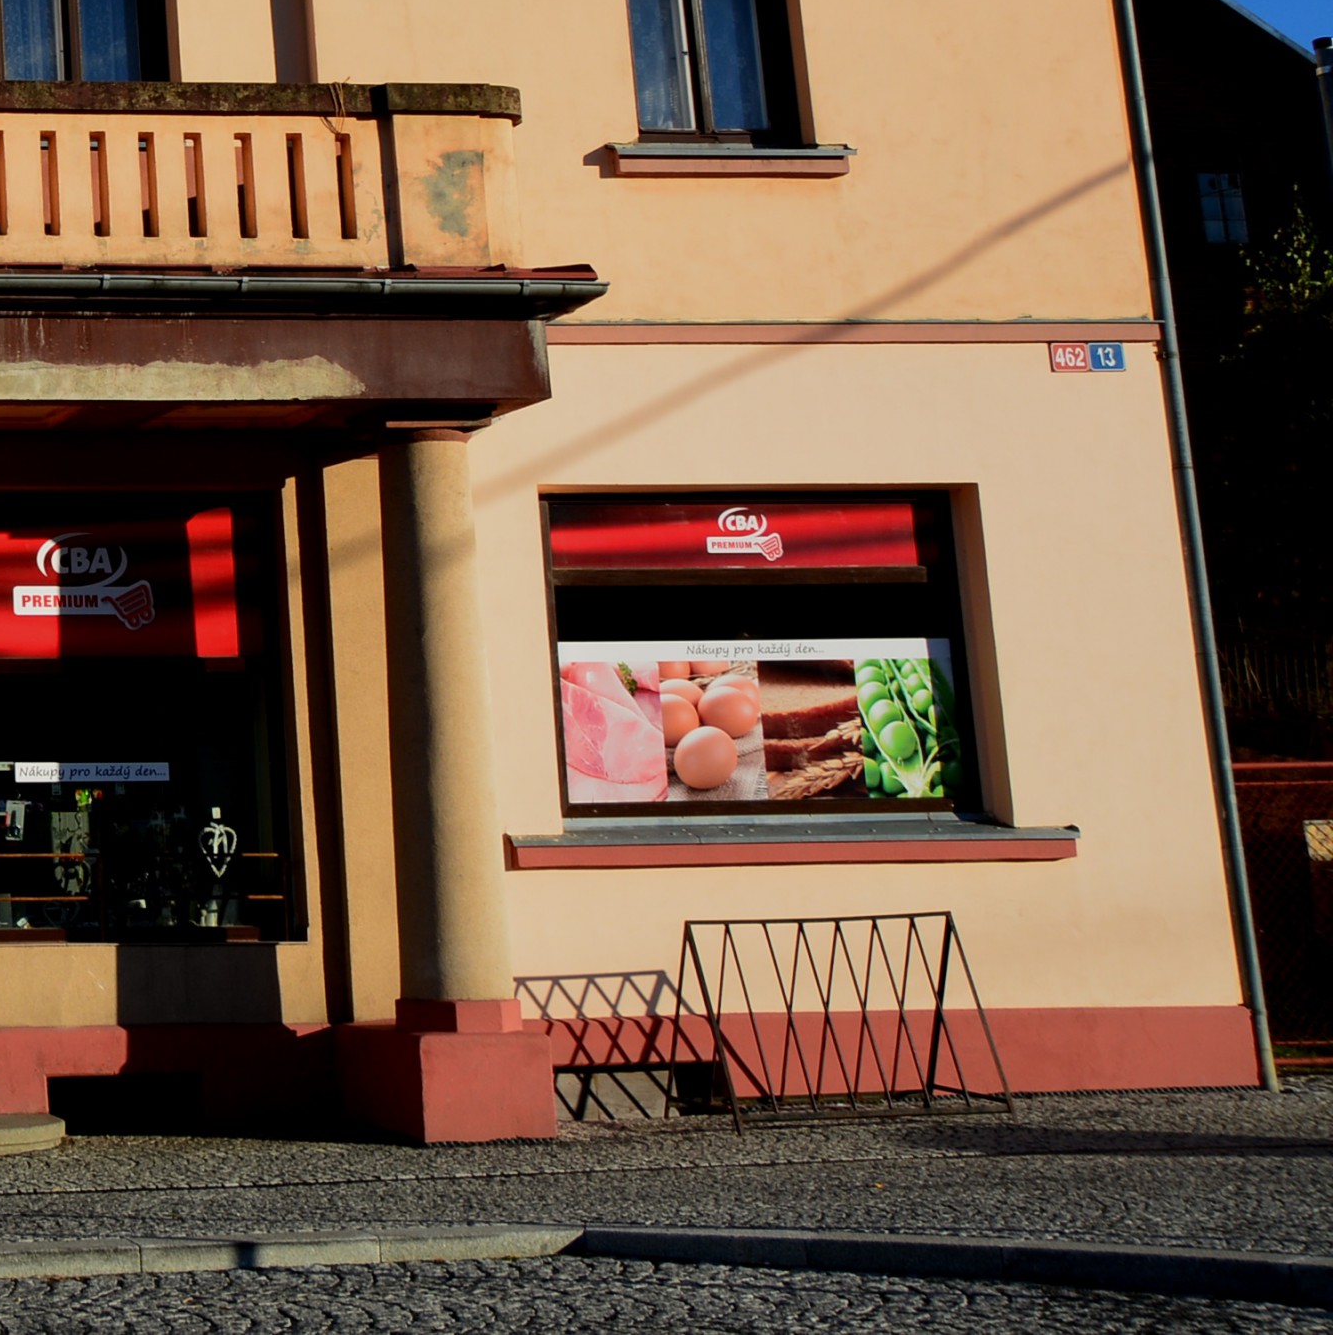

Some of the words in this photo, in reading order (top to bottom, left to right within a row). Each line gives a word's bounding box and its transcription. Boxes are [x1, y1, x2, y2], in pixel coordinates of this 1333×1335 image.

[1055, 347, 1086, 367] 462
[1096, 347, 1116, 367] 13
[725, 515, 760, 531] CBA
[711, 541, 753, 550] PREMIUM
[50, 546, 113, 575] CBA
[21, 594, 99, 609] PREMIUM
[686, 644, 729, 658] Nákupy
[733, 646, 754, 657] pro
[757, 643, 791, 657] každý
[794, 642, 824, 654] den...
[19, 766, 65, 780] Nákupy
[69, 767, 91, 780] pro
[95, 765, 131, 779] každý
[135, 765, 166, 777] den...
